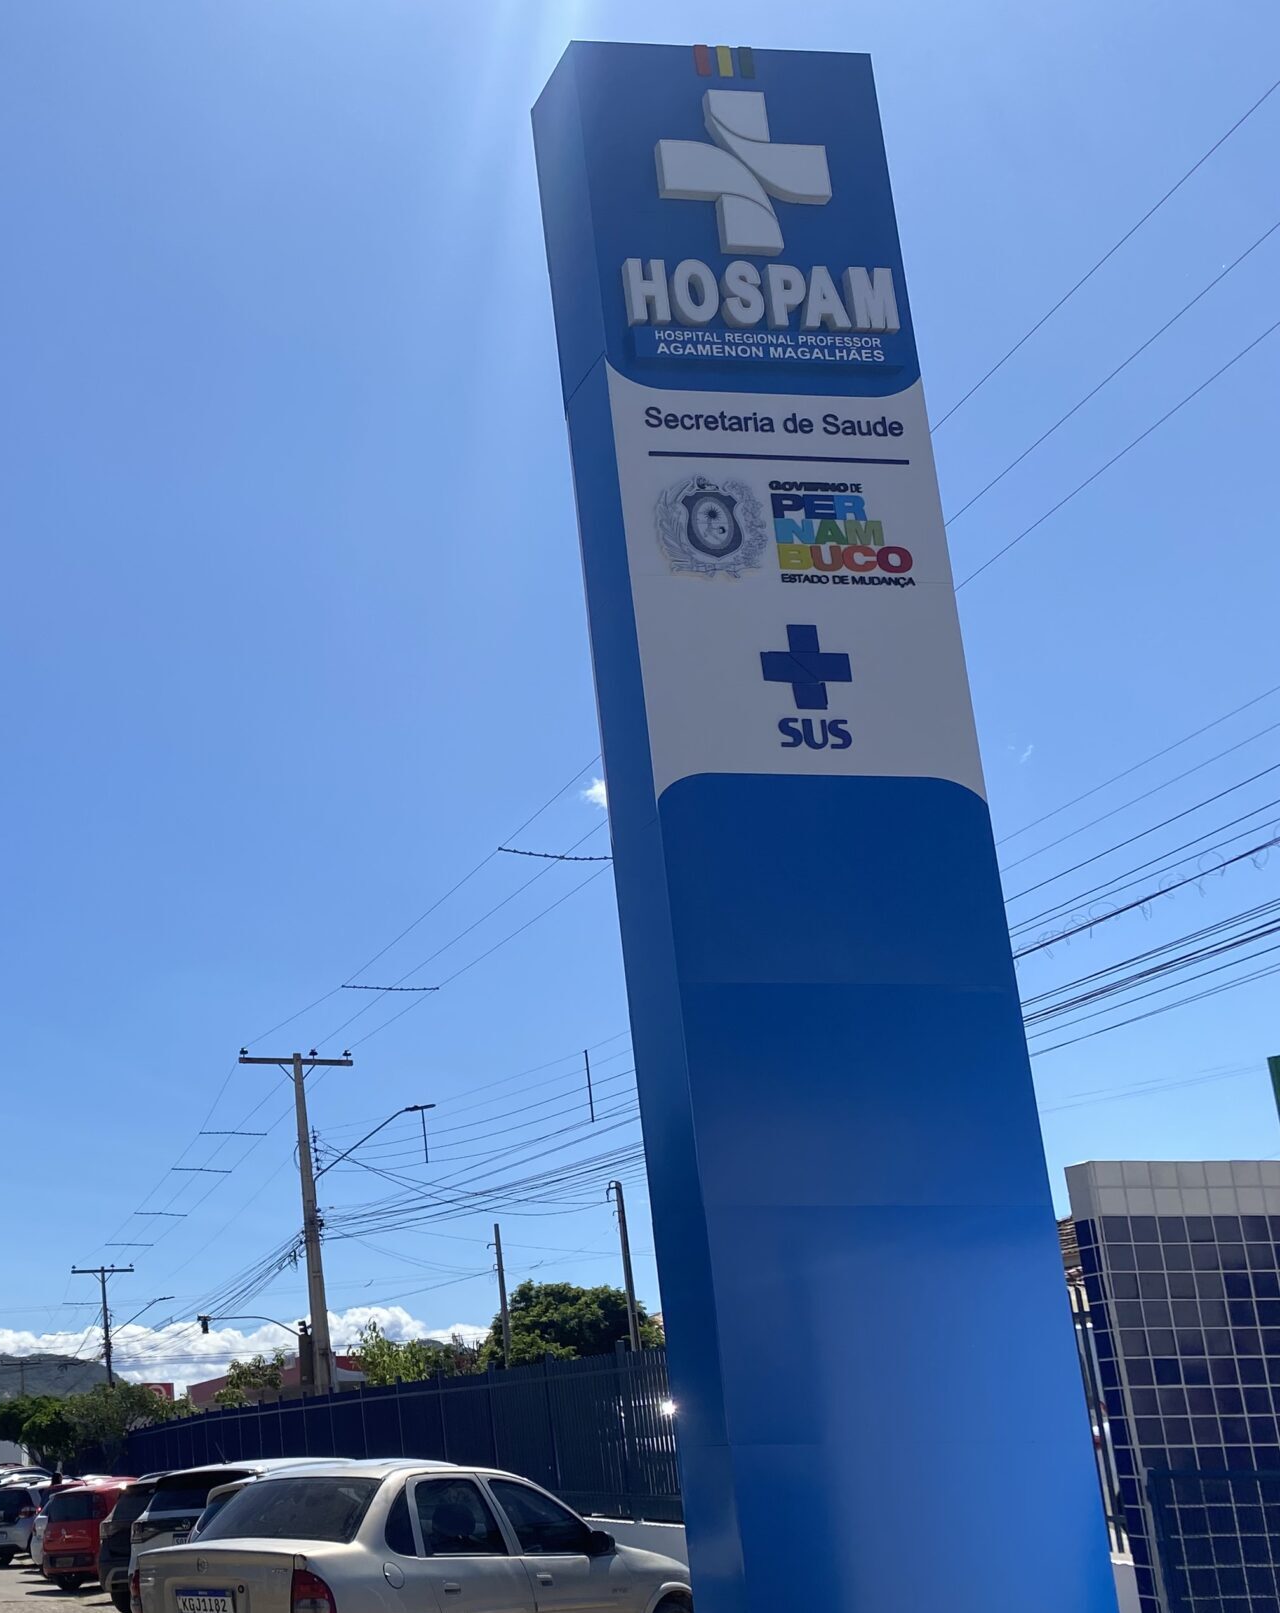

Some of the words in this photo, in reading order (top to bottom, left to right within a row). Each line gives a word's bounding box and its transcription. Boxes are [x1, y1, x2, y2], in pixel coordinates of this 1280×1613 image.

[622, 258, 900, 333] HOSPAM
[655, 330, 722, 343] HOSPITAL
[725, 333, 795, 346] REGIONAL
[798, 335, 882, 348] PROFESSOR
[657, 342, 764, 358] AGAMENON
[769, 346, 885, 362] MAGALHÃES
[644, 406, 775, 433] Secretaria
[782, 412, 814, 434] de
[822, 413, 904, 438] Saude
[850, 483, 863, 493] DE
[770, 493, 867, 521] PER
[773, 518, 884, 546] NAM
[776, 543, 913, 573] BUCO
[781, 573, 830, 585] ESTADO
[832, 575, 850, 585] DE
[851, 575, 916, 588] MUDANÇA
[778, 717, 852, 750] SUS
